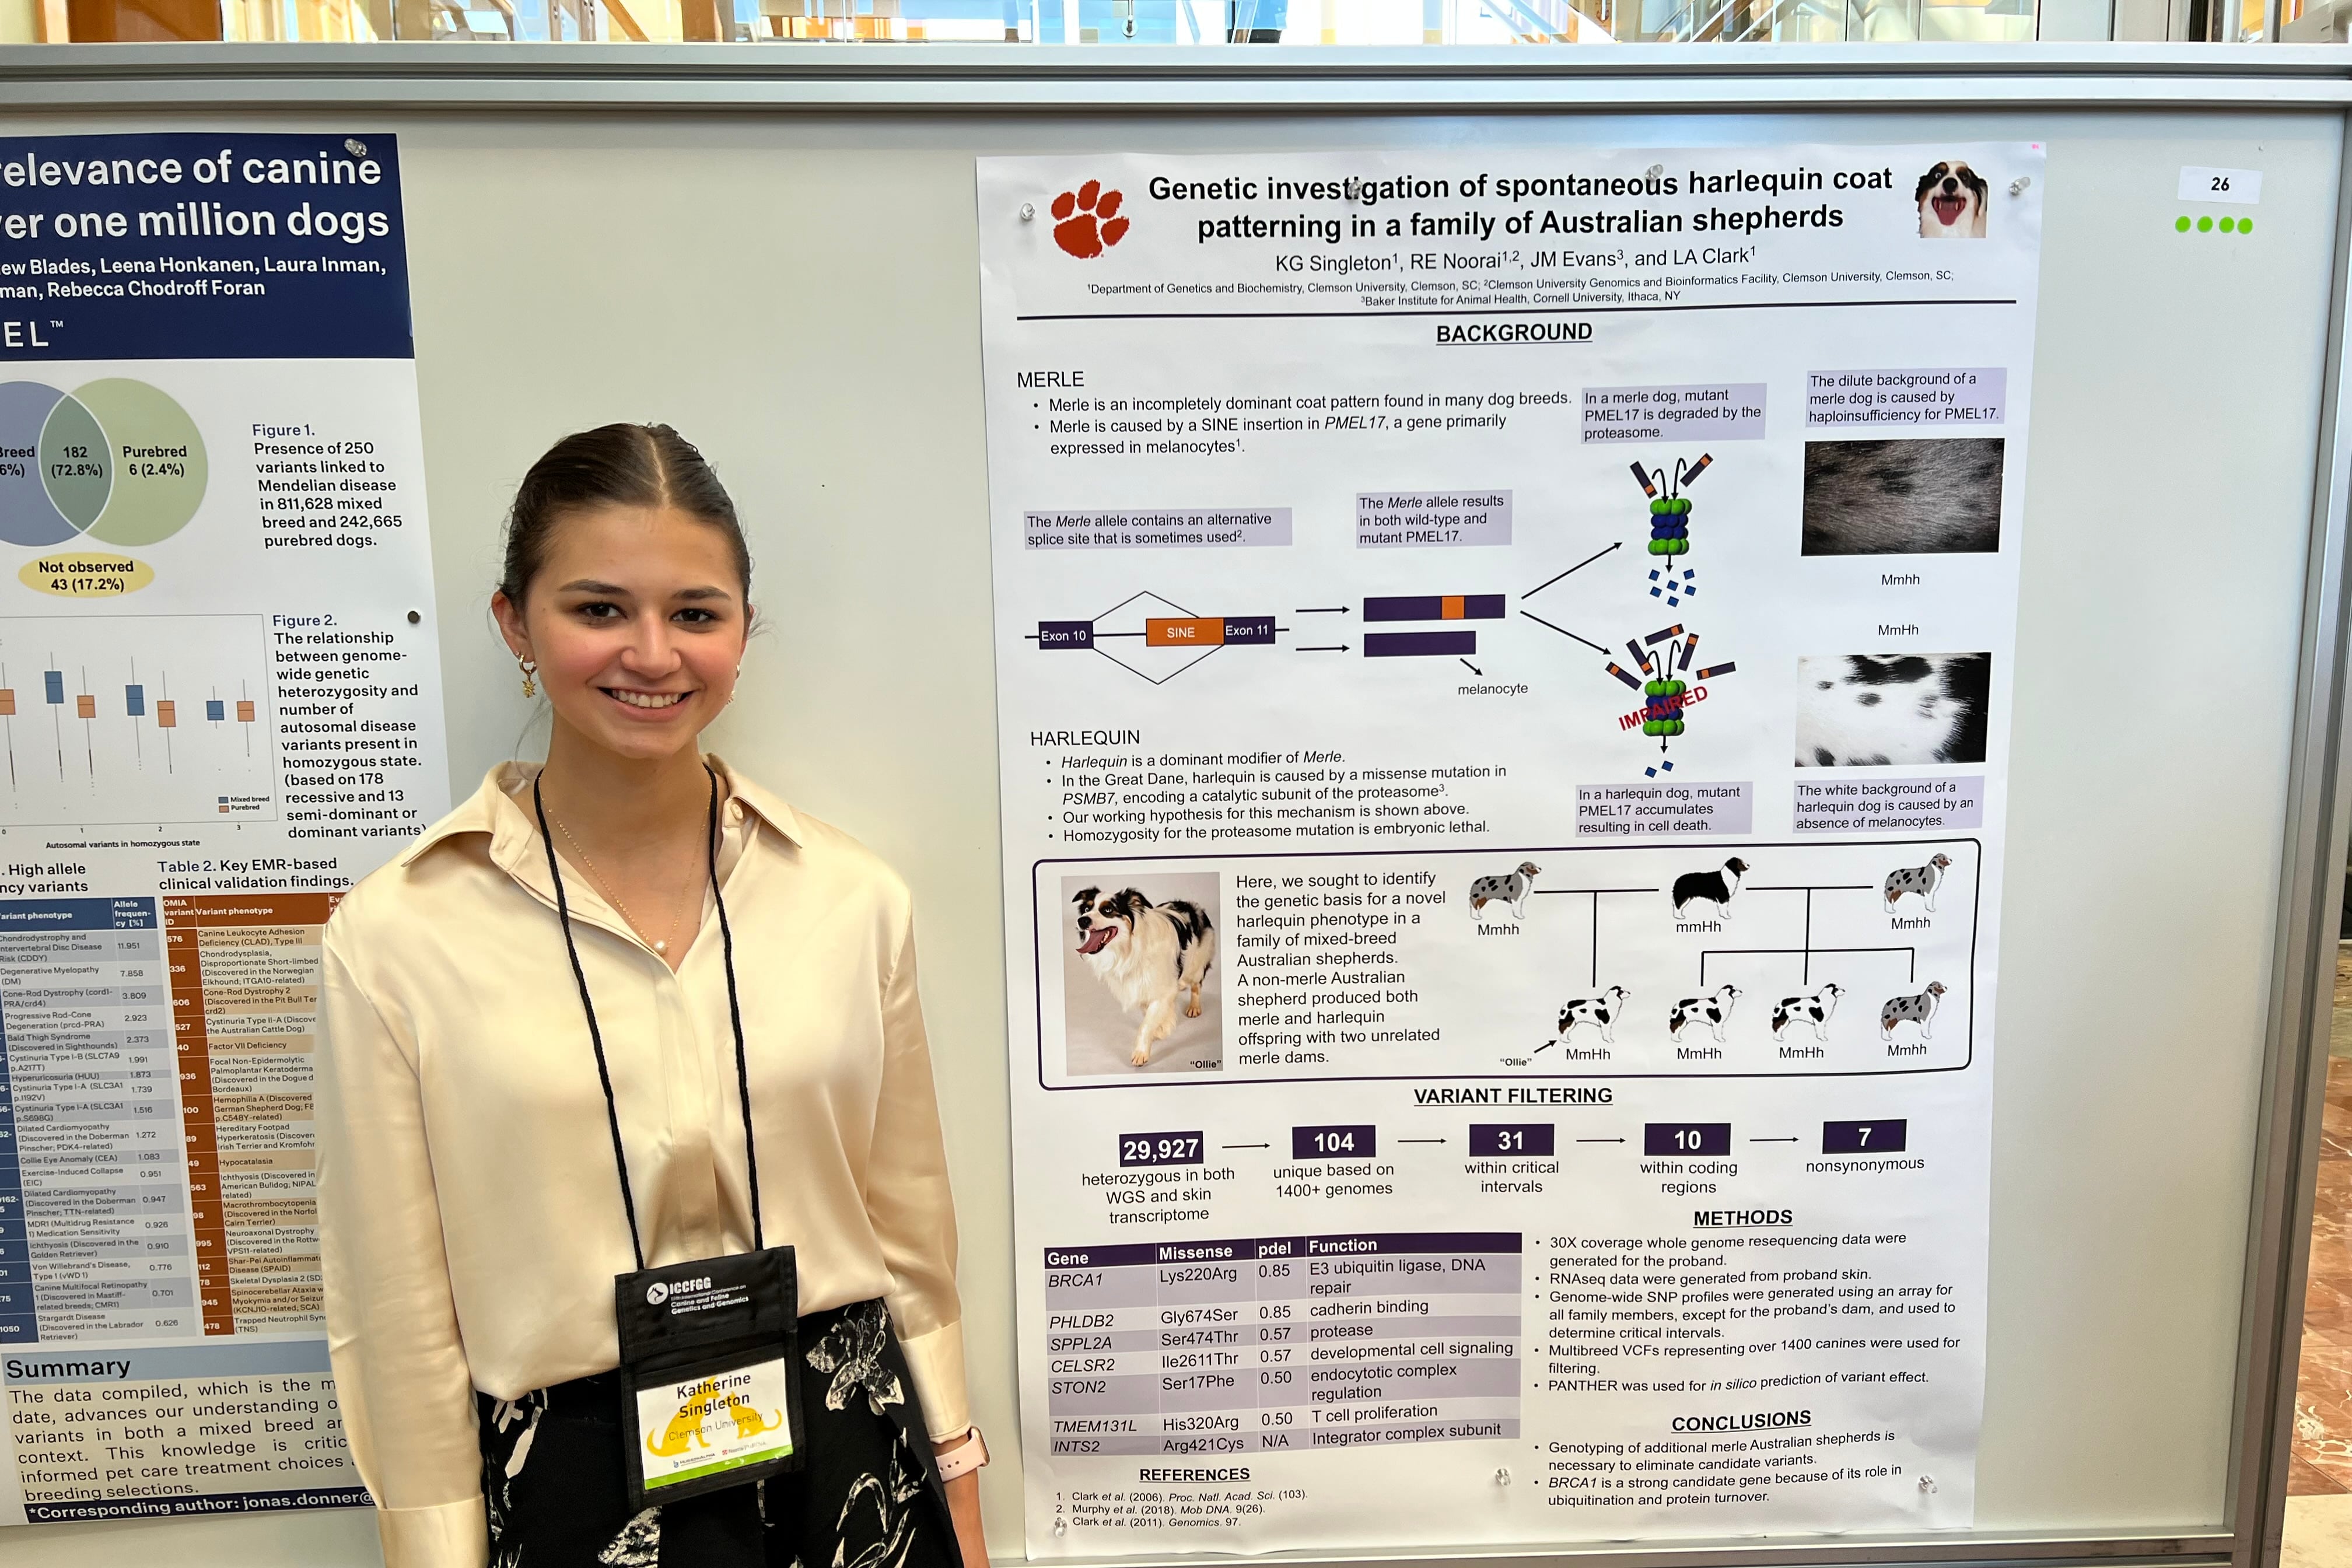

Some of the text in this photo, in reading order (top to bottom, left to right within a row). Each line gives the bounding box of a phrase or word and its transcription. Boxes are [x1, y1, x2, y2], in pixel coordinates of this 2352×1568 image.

[194, 149, 232, 183] of
[243, 151, 380, 185] canine
[1149, 176, 1258, 200] Genetic
[1460, 174, 1488, 197] of
[1496, 175, 1678, 203] spontaneous
[1689, 167, 1822, 197] harlequin
[1833, 167, 1892, 190] coat
[2211, 177, 2230, 192] 26
[0, 202, 389, 244] er one million dogs
[1199, 204, 1843, 244] patterning in a family of Australian shepherds
[0, 256, 386, 276] ew Blades, Leena Honkanen, Laura Inman,
[1436, 323, 1592, 343] BACKGROUND
[1017, 371, 1084, 388] MERLE
[1811, 373, 1976, 388] The dilute background of a
[1810, 391, 1954, 407] merle dog is caused by
[1809, 407, 1999, 425] haploinsufficiency for PMEL17.
[253, 424, 315, 439] Figure 1.
[63, 446, 88, 459] 182
[123, 445, 187, 459] Purebred
[254, 442, 374, 455] Presence of 250
[51, 462, 103, 478] (72.8%)
[129, 462, 185, 478] 6 (2.4%)
[257, 460, 384, 473] variants linked to
[258, 478, 396, 492] Mendelian disease
[38, 560, 134, 573] Not observed
[51, 578, 124, 593] 43 (17.2%)
[1881, 574, 1920, 585] Mmhh
[1041, 630, 1086, 642] Exon 10
[1167, 627, 1195, 639] SINE
[1226, 625, 1268, 636] Exon 11
[1878, 624, 1919, 636] MmHh
[1458, 683, 1528, 697] melanocyte
[1619, 686, 1708, 732] IMPAIRED
[1030, 730, 1140, 747] HARLEQUIN
[158, 857, 337, 873] Table 2. Key EMR-based
[159, 874, 354, 890] clinical validation findings.
[1478, 923, 1520, 936] Mmhh
[1675, 920, 1721, 933] mmHh
[1891, 918, 1931, 931] Mmhh
[226, 929, 268, 938] Leukocyte
[268, 928, 305, 936] Adhesion
[199, 939, 240, 948] Deficiency
[241, 938, 273, 947] (CLAD),
[274, 937, 295, 946] Type
[120, 970, 144, 978] 7.858
[1566, 1048, 1611, 1061] MmHh
[1677, 1047, 1722, 1060] MmHh
[1779, 1046, 1824, 1059] MmHh
[1887, 1044, 1927, 1056] Mmhh
[1414, 1087, 1613, 1104] VARIANT FILTERING
[1314, 1132, 1354, 1153] 104
[1498, 1130, 1524, 1151] 31
[1674, 1129, 1702, 1150] 10
[1858, 1128, 1872, 1146] 7
[1124, 1138, 1199, 1163] 29,927
[1806, 1157, 1925, 1175] nonsynonymous
[1694, 1210, 1793, 1224] METHODS
[1048, 1238, 1378, 1266] Gene Missense pdel Function
[1048, 1266, 1237, 1288] BRCA1 Lys220Arg
[670, 1277, 712, 1294] ICCFGG
[1049, 1308, 1238, 1330] PHLDB2 Gly674Ser
[1051, 1330, 1238, 1352] SPPL2A Ser474Thr
[6, 1358, 131, 1379] Summary
[1051, 1352, 1238, 1373] CELSR2 Ile2611Thr
[677, 1374, 751, 1399] Katherine
[1052, 1374, 1235, 1395] STON2 Ser17Phe
[679, 1394, 750, 1419] Singleton
[669, 1412, 763, 1441] Clemson University
[1053, 1415, 1239, 1434] TMEM131L His320Arg
[1672, 1410, 1812, 1431] CONCLUSIONS
[1053, 1437, 1244, 1455] INTS2 Arg421Cys
[1140, 1466, 1251, 1482] REFERENCES
[24, 1482, 199, 1503] breeding selections.
[174, 1497, 240, 1514] author:
[1056, 1504, 1266, 1517] 2. Murphy et al. (2018). Mob DNA. 9(26).
